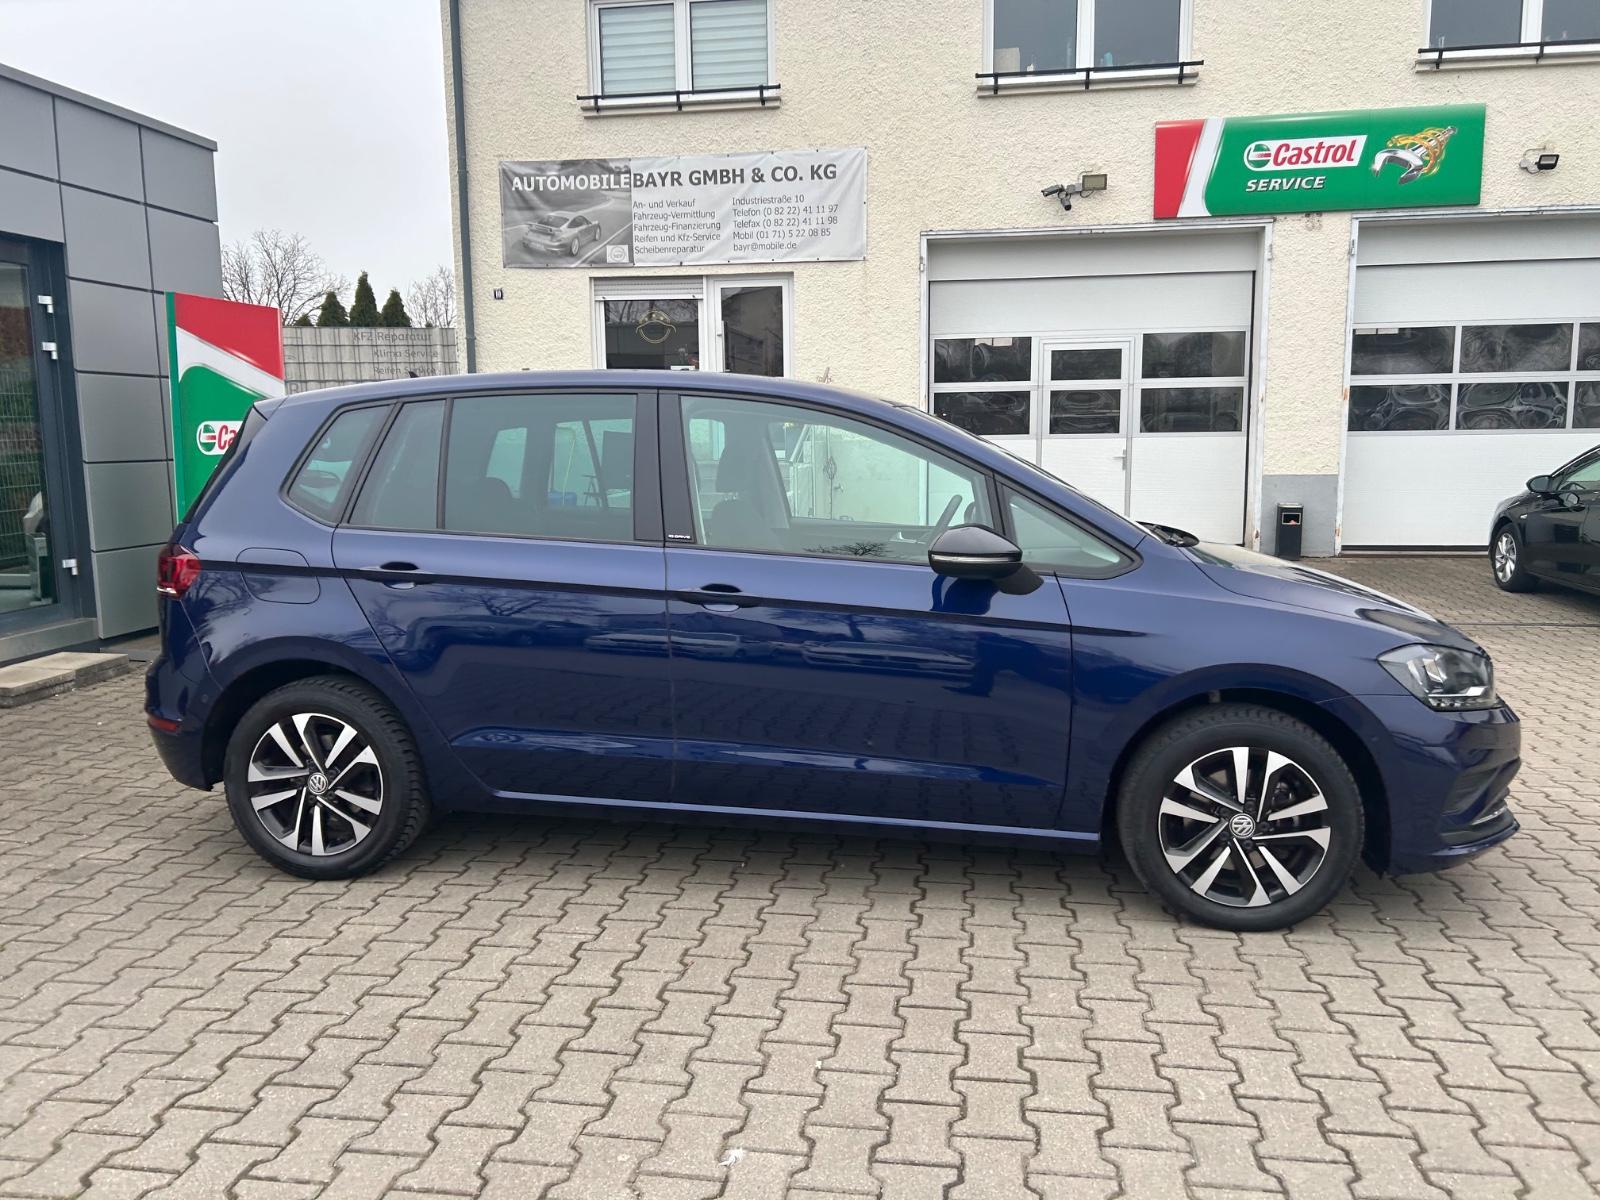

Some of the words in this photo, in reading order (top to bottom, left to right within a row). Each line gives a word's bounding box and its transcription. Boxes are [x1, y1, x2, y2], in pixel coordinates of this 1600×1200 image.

[1273, 139, 1357, 166] Castrol
[512, 173, 630, 191] AUTOMOBILE
[633, 171, 683, 188] BAYR
[688, 168, 745, 186] GMBH
[751, 167, 765, 183] &
[771, 165, 803, 182] CO.
[810, 163, 837, 181] KG
[1245, 176, 1326, 192] SERVICE
[633, 201, 646, 209] An-
[648, 200, 664, 209] und
[666, 198, 696, 208] Verkauf
[732, 194, 792, 206] Industriestraße
[795, 194, 805, 203] 10
[633, 209, 716, 221] Fahrzeug-Vermittlung
[733, 207, 761, 217] Telefon
[763, 206, 772, 217] (0
[774, 207, 784, 215] 82
[787, 206, 801, 216] 22)
[803, 205, 812, 214] 41
[816, 205, 825, 214] 11
[828, 204, 839, 213] 97
[633, 222, 721, 233] Fahrzeug-Finanzierung
[733, 219, 761, 229] Telefax
[762, 218, 772, 229] (0
[774, 218, 784, 227] 82
[786, 217, 800, 228] 22)
[802, 217, 812, 225] 41
[816, 216, 825, 225] 11
[828, 215, 838, 225] 98
[634, 234, 658, 243] Reifen
[661, 234, 676, 242] und
[677, 232, 721, 241] Kfz-Service
[733, 231, 754, 240] Mobil
[756, 229, 770, 241] (01
[772, 229, 786, 240] 71)
[788, 229, 794, 238] 5
[795, 229, 806, 238] 22
[808, 228, 818, 237] 08
[820, 227, 831, 237] 85
[634, 245, 705, 254] Scheibenreparatur
[733, 241, 797, 252] bayr@mobile.de
